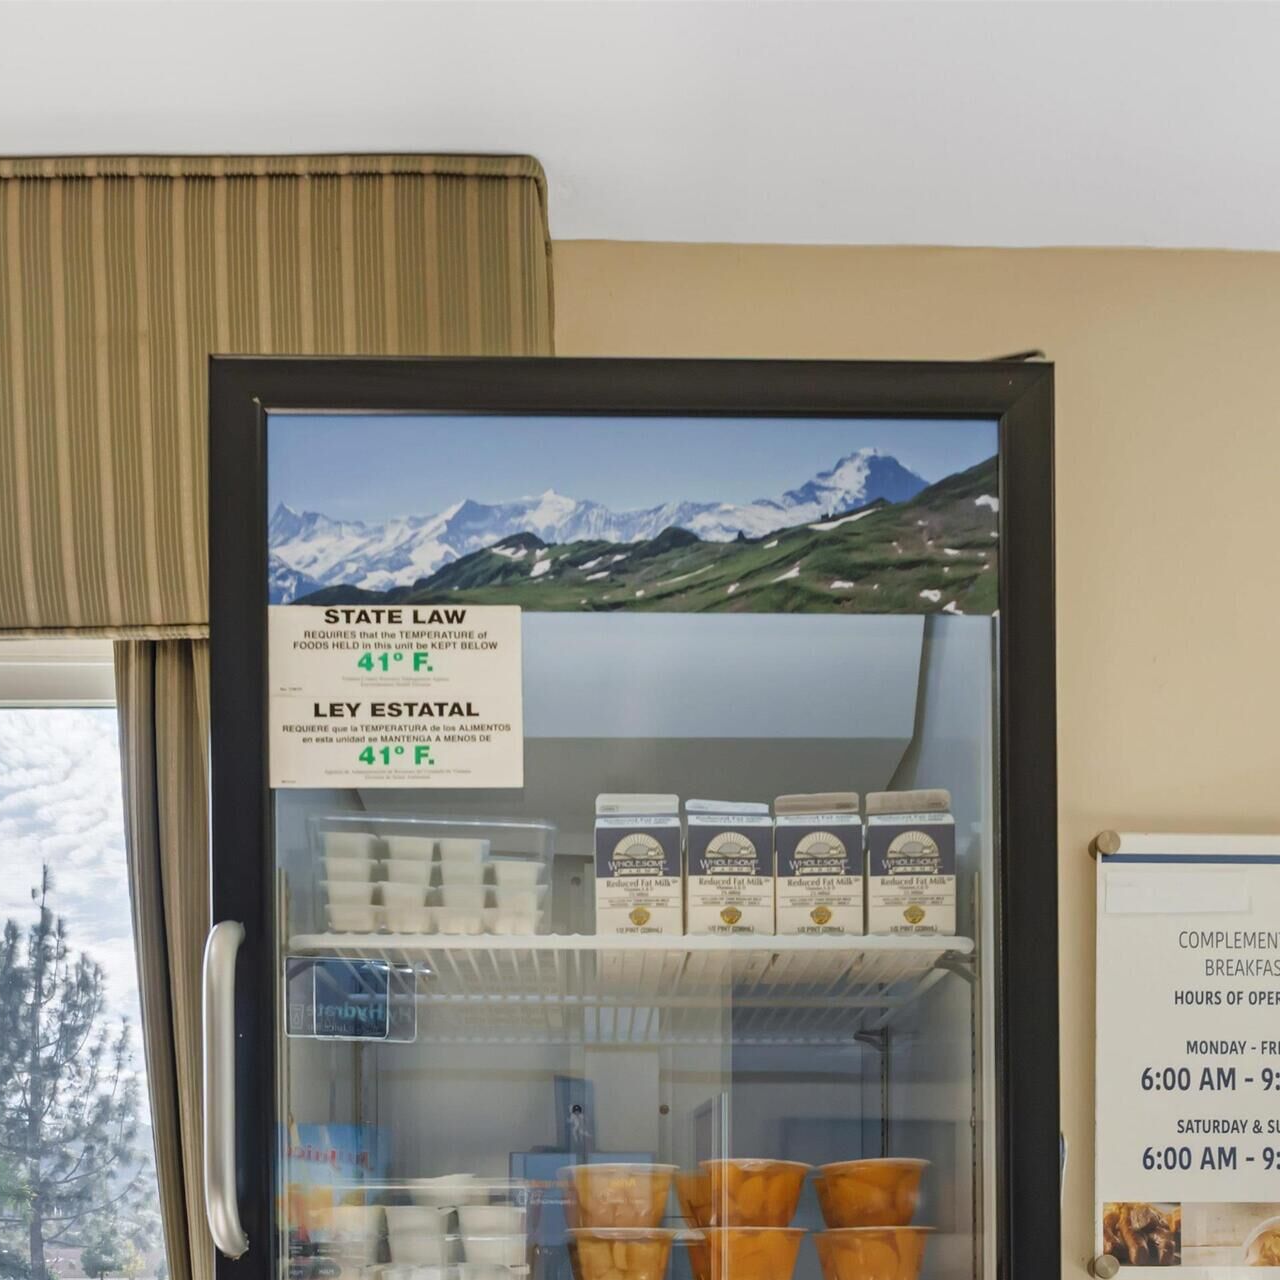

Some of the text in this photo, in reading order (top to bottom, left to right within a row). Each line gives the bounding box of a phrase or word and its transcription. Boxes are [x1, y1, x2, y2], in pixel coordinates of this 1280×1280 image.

[324, 609, 467, 624] STATE LAW
[303, 630, 487, 640] REQUIRES that the TEMPERATURE of
[293, 641, 498, 650] FOODS HELD in this unit be KEPT BELOW
[413, 652, 433, 672] F.
[313, 702, 479, 718] LEY ESTATAL
[282, 724, 511, 735] REQUIERE que la TEMPERATURA de los ALIMENTOS
[315, 736, 333, 744] esta
[336, 735, 366, 743] unidad
[380, 735, 432, 743] MANTENGA
[435, 735, 442, 743] A
[444, 735, 477, 743] MENOS
[479, 735, 492, 743] DE
[414, 746, 435, 765] F.
[1174, 991, 1222, 1006] HOURS
[1226, 991, 1244, 1006] OF
[1186, 1040, 1247, 1055] MONDAY
[1141, 1067, 1192, 1091] 6:00
[1199, 1067, 1237, 1091] AM
[1176, 1119, 1248, 1134] SATURDAY
[1252, 1119, 1263, 1134] &
[1142, 1146, 1192, 1170] 6:00
[1200, 1146, 1237, 1170] AM
